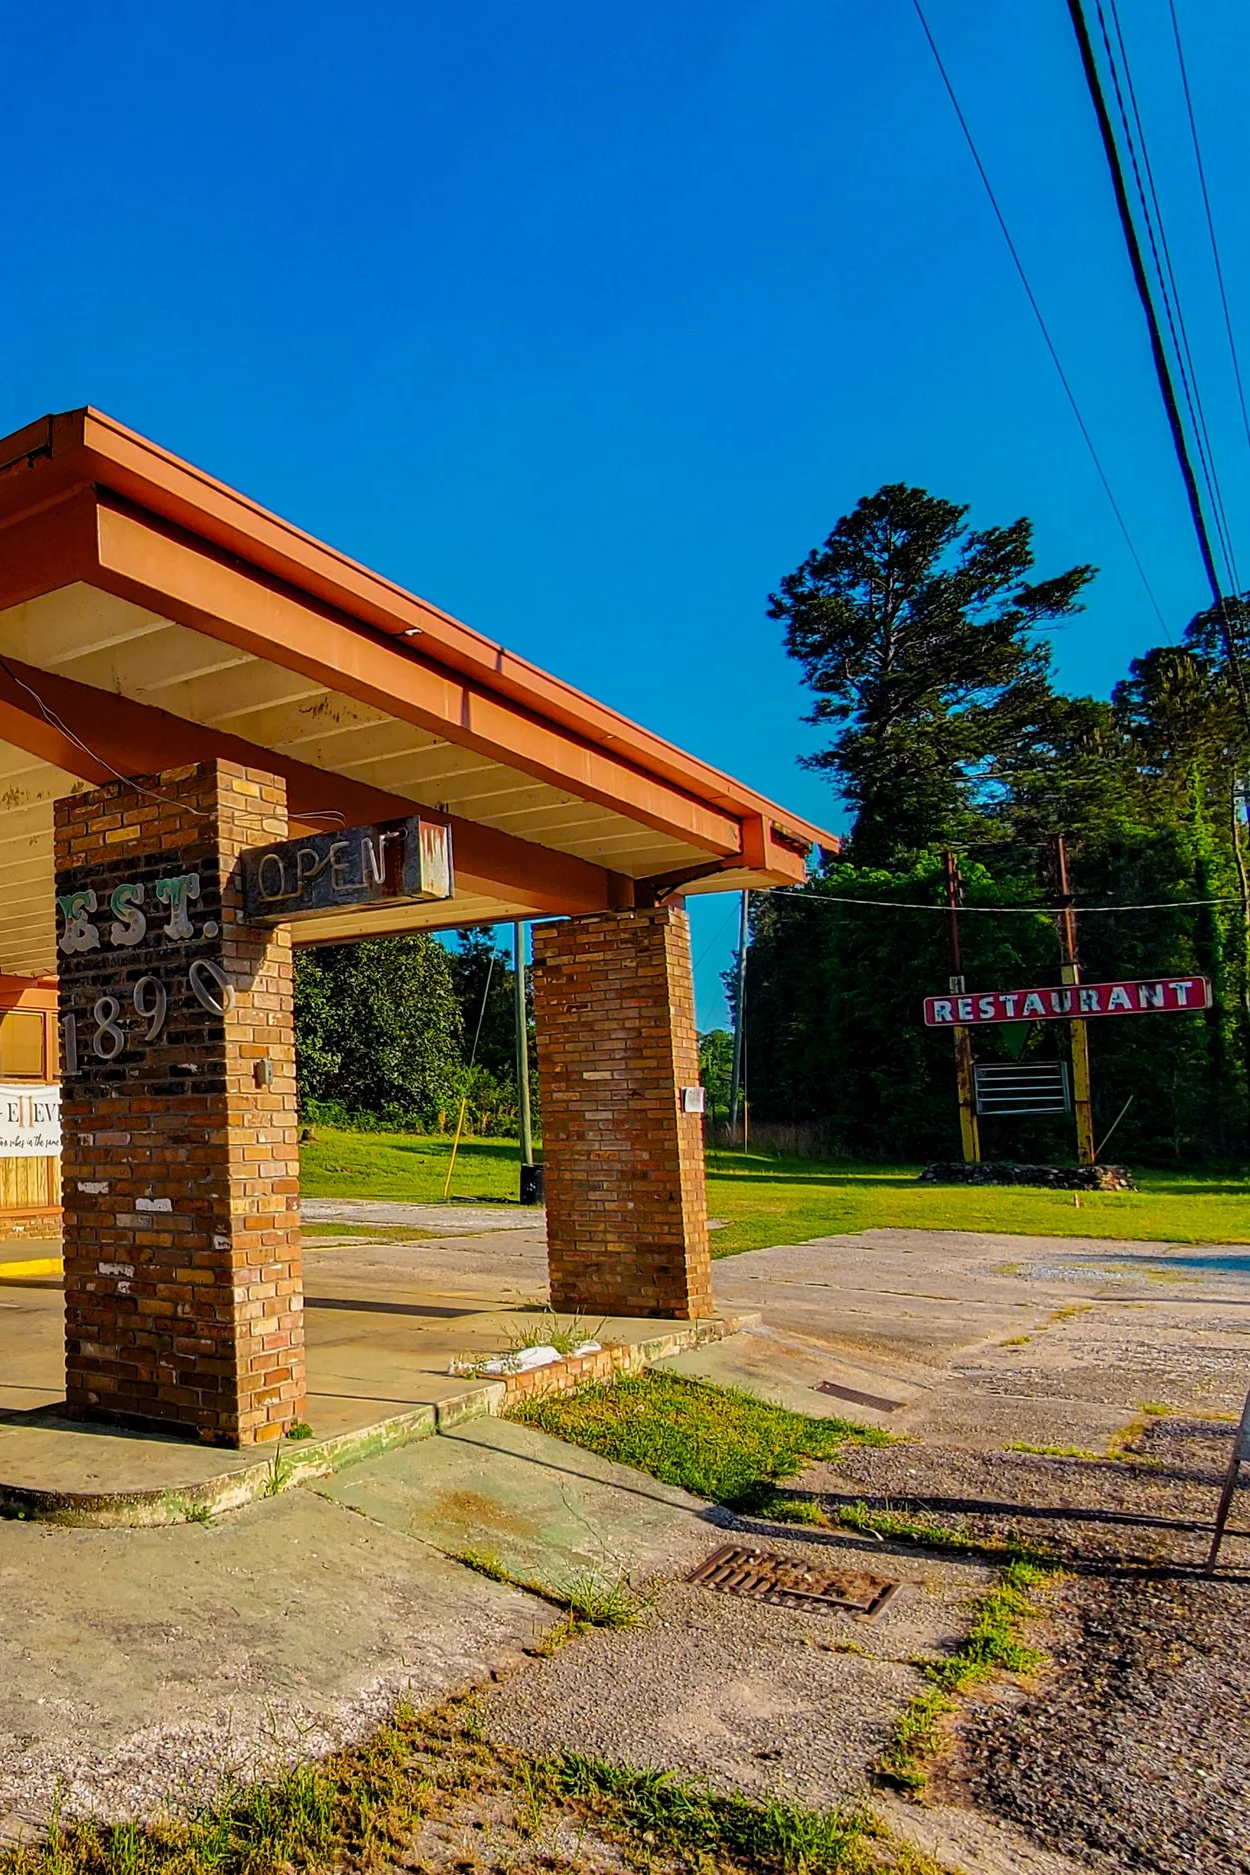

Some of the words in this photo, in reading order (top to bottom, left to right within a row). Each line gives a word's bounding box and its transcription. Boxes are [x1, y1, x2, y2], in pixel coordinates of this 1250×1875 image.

[258, 837, 388, 901] OPEN
[57, 873, 220, 955] EST.
[59, 958, 236, 1076] 1890
[933, 981, 1193, 1022] RESTAURANT
[33, 1133, 44, 1147] the
